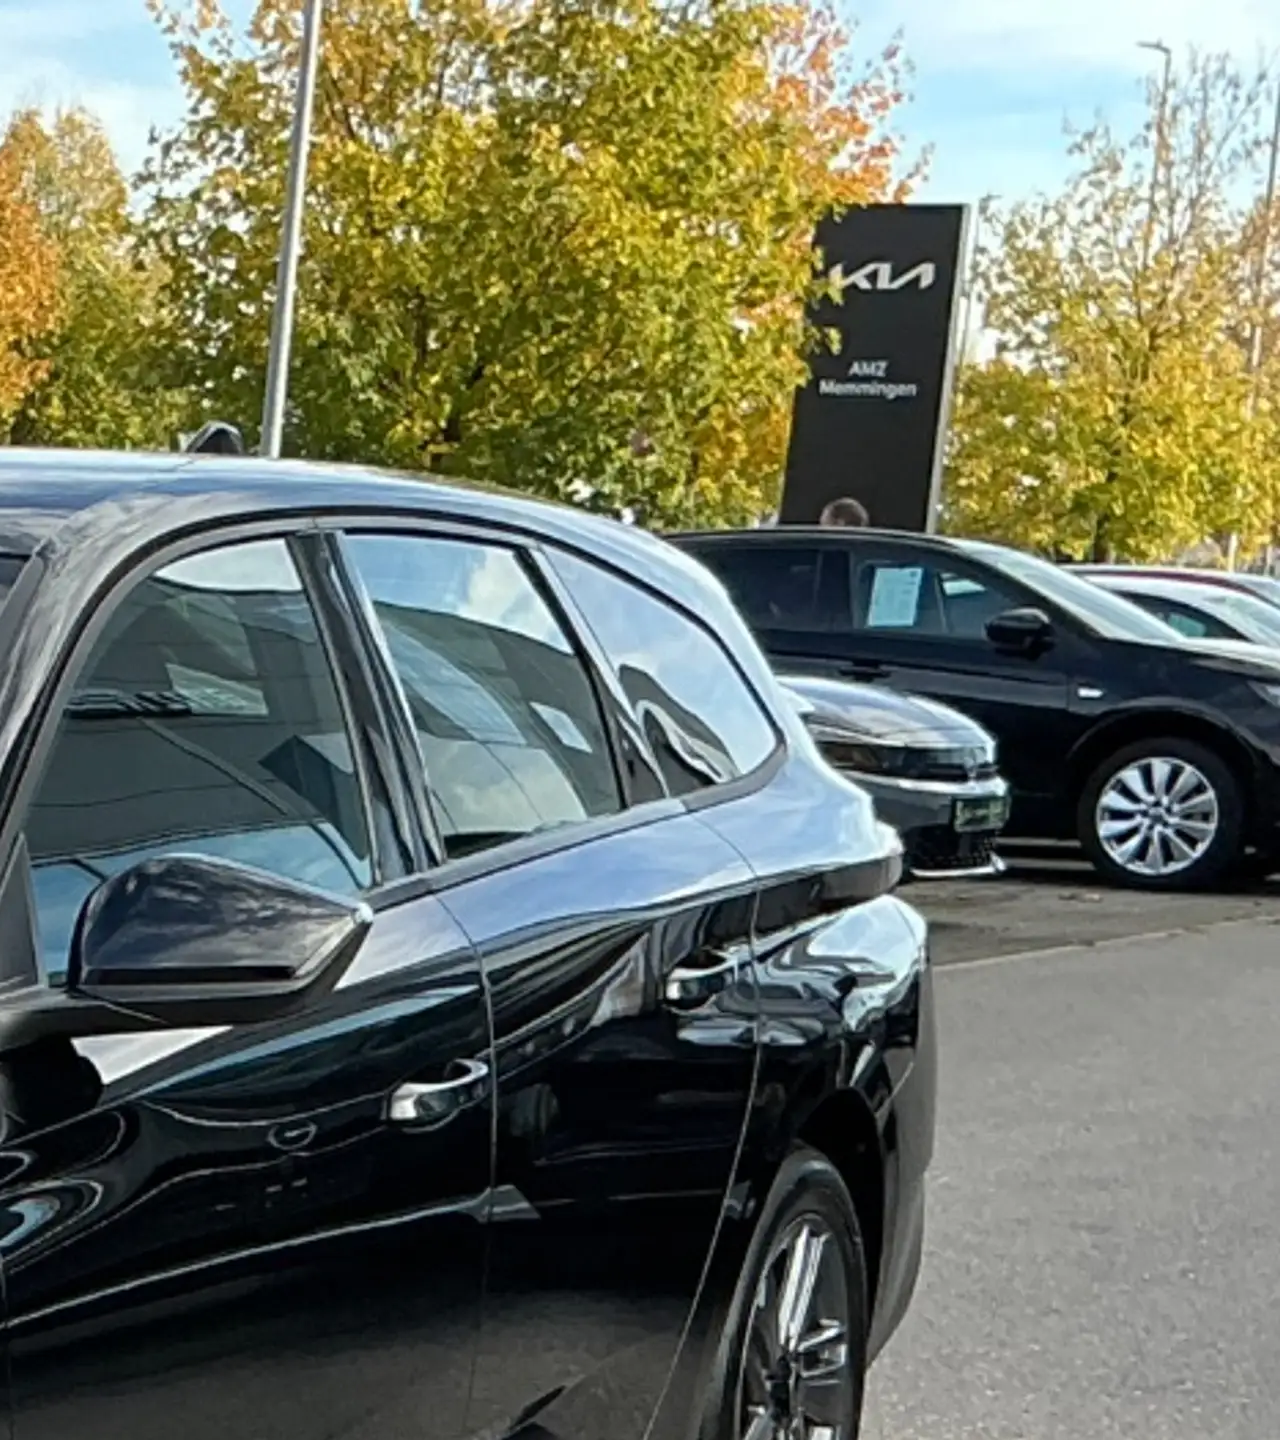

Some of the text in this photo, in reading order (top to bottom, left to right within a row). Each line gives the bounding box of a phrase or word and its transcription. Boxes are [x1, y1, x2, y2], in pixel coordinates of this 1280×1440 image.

[828, 261, 936, 290] KIA
[848, 360, 889, 378] AMZ
[818, 379, 917, 399] Memmingen
